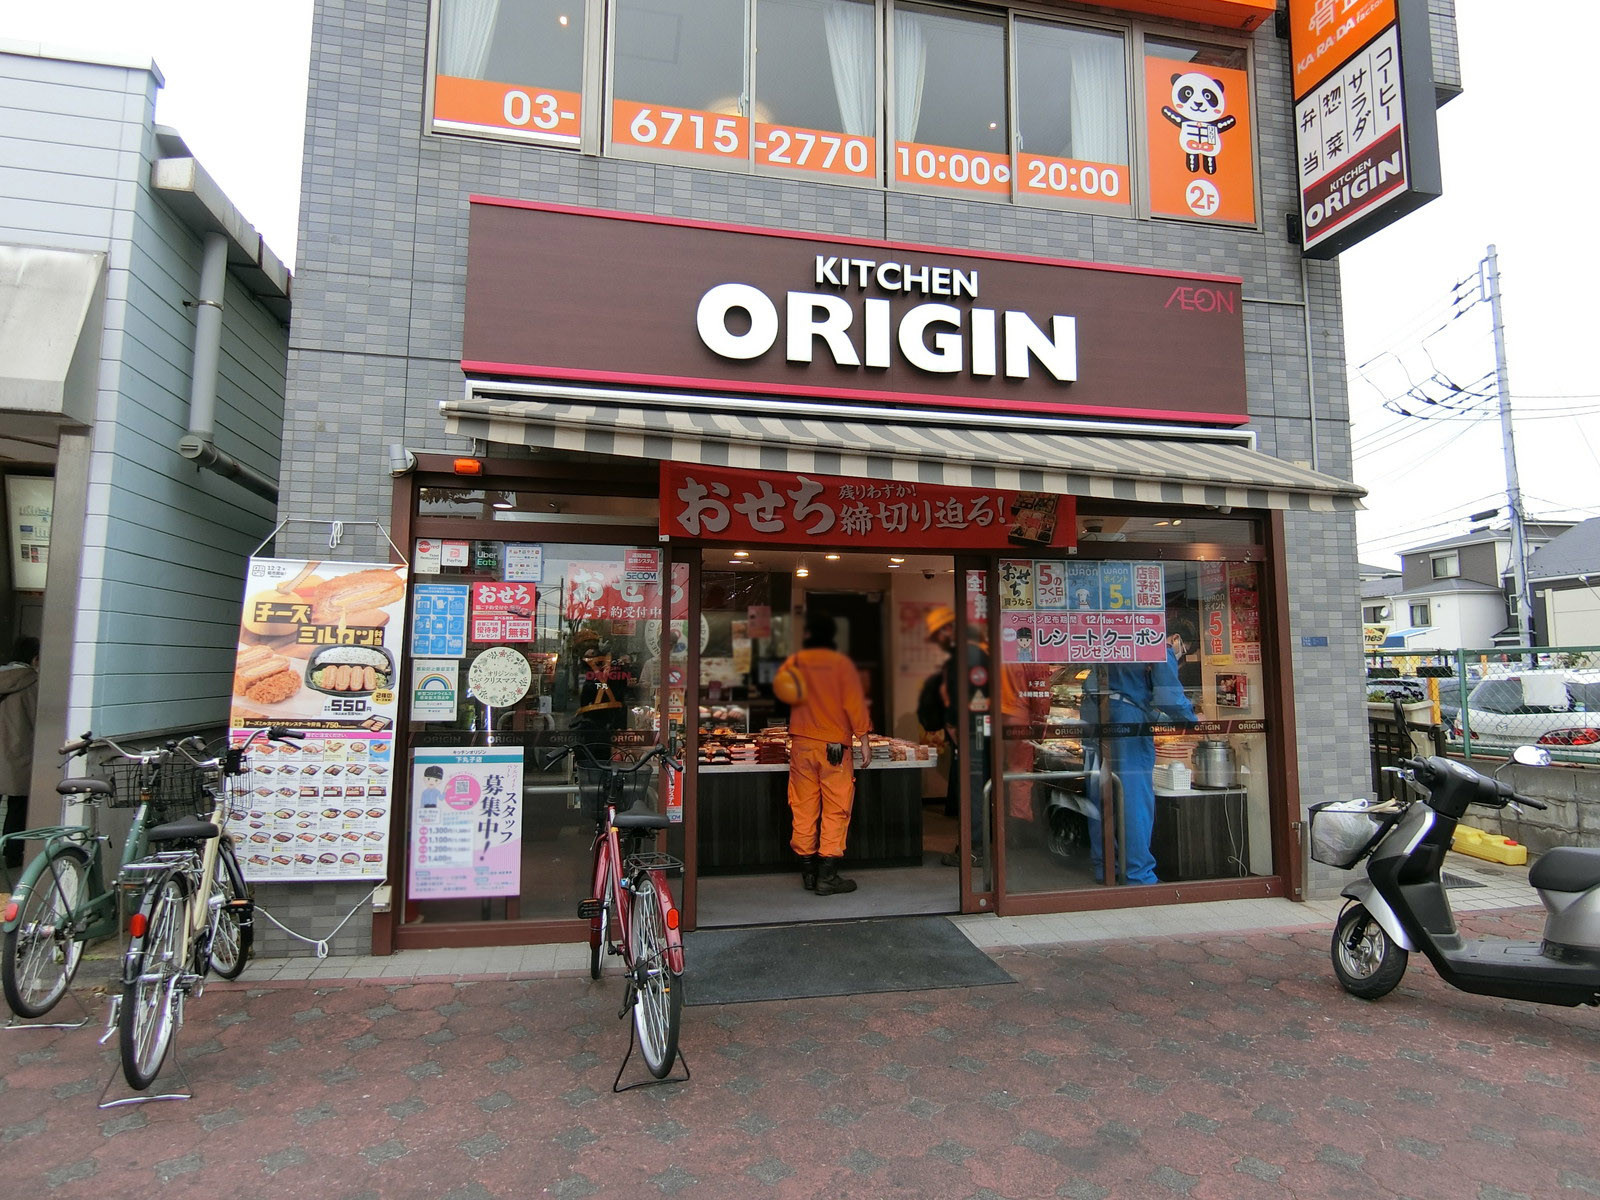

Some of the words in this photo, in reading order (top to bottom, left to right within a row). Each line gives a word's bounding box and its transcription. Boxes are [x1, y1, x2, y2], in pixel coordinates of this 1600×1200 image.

[1376, 46, 1397, 121] コーヒー
[1349, 68, 1371, 142] サラダ
[503, 90, 575, 129] 03-
[630, 109, 739, 153] 6715
[755, 130, 868, 173] -2770
[1323, 86, 1344, 160] 惣菜
[1300, 108, 1319, 176] 弁当
[897, 147, 991, 186] 10:00
[1028, 161, 1119, 197] 20:00
[1306, 150, 1400, 228] ORIGIN
[1330, 158, 1371, 192] KITCHEN
[1190, 185, 1215, 210] 2F
[816, 255, 979, 299] KITCHEN
[697, 283, 1077, 382] ORIGIN
[676, 475, 836, 536] おせち
[839, 495, 1006, 536] 締切り迫る!
[626, 572, 657, 580] SECOM
[968, 575, 987, 592] 全
[1002, 562, 1031, 597] おせち
[1136, 566, 1160, 579] 店舗
[1136, 580, 1160, 592] 予約
[478, 585, 531, 604] おせち
[1039, 587, 1063, 597] つく日
[1136, 594, 1161, 606] 限定
[256, 603, 311, 623] チーズ
[1038, 629, 1164, 646] レシートクーポン
[487, 736, 524, 744] ORIGIN
[501, 792, 517, 843] スタッフ
